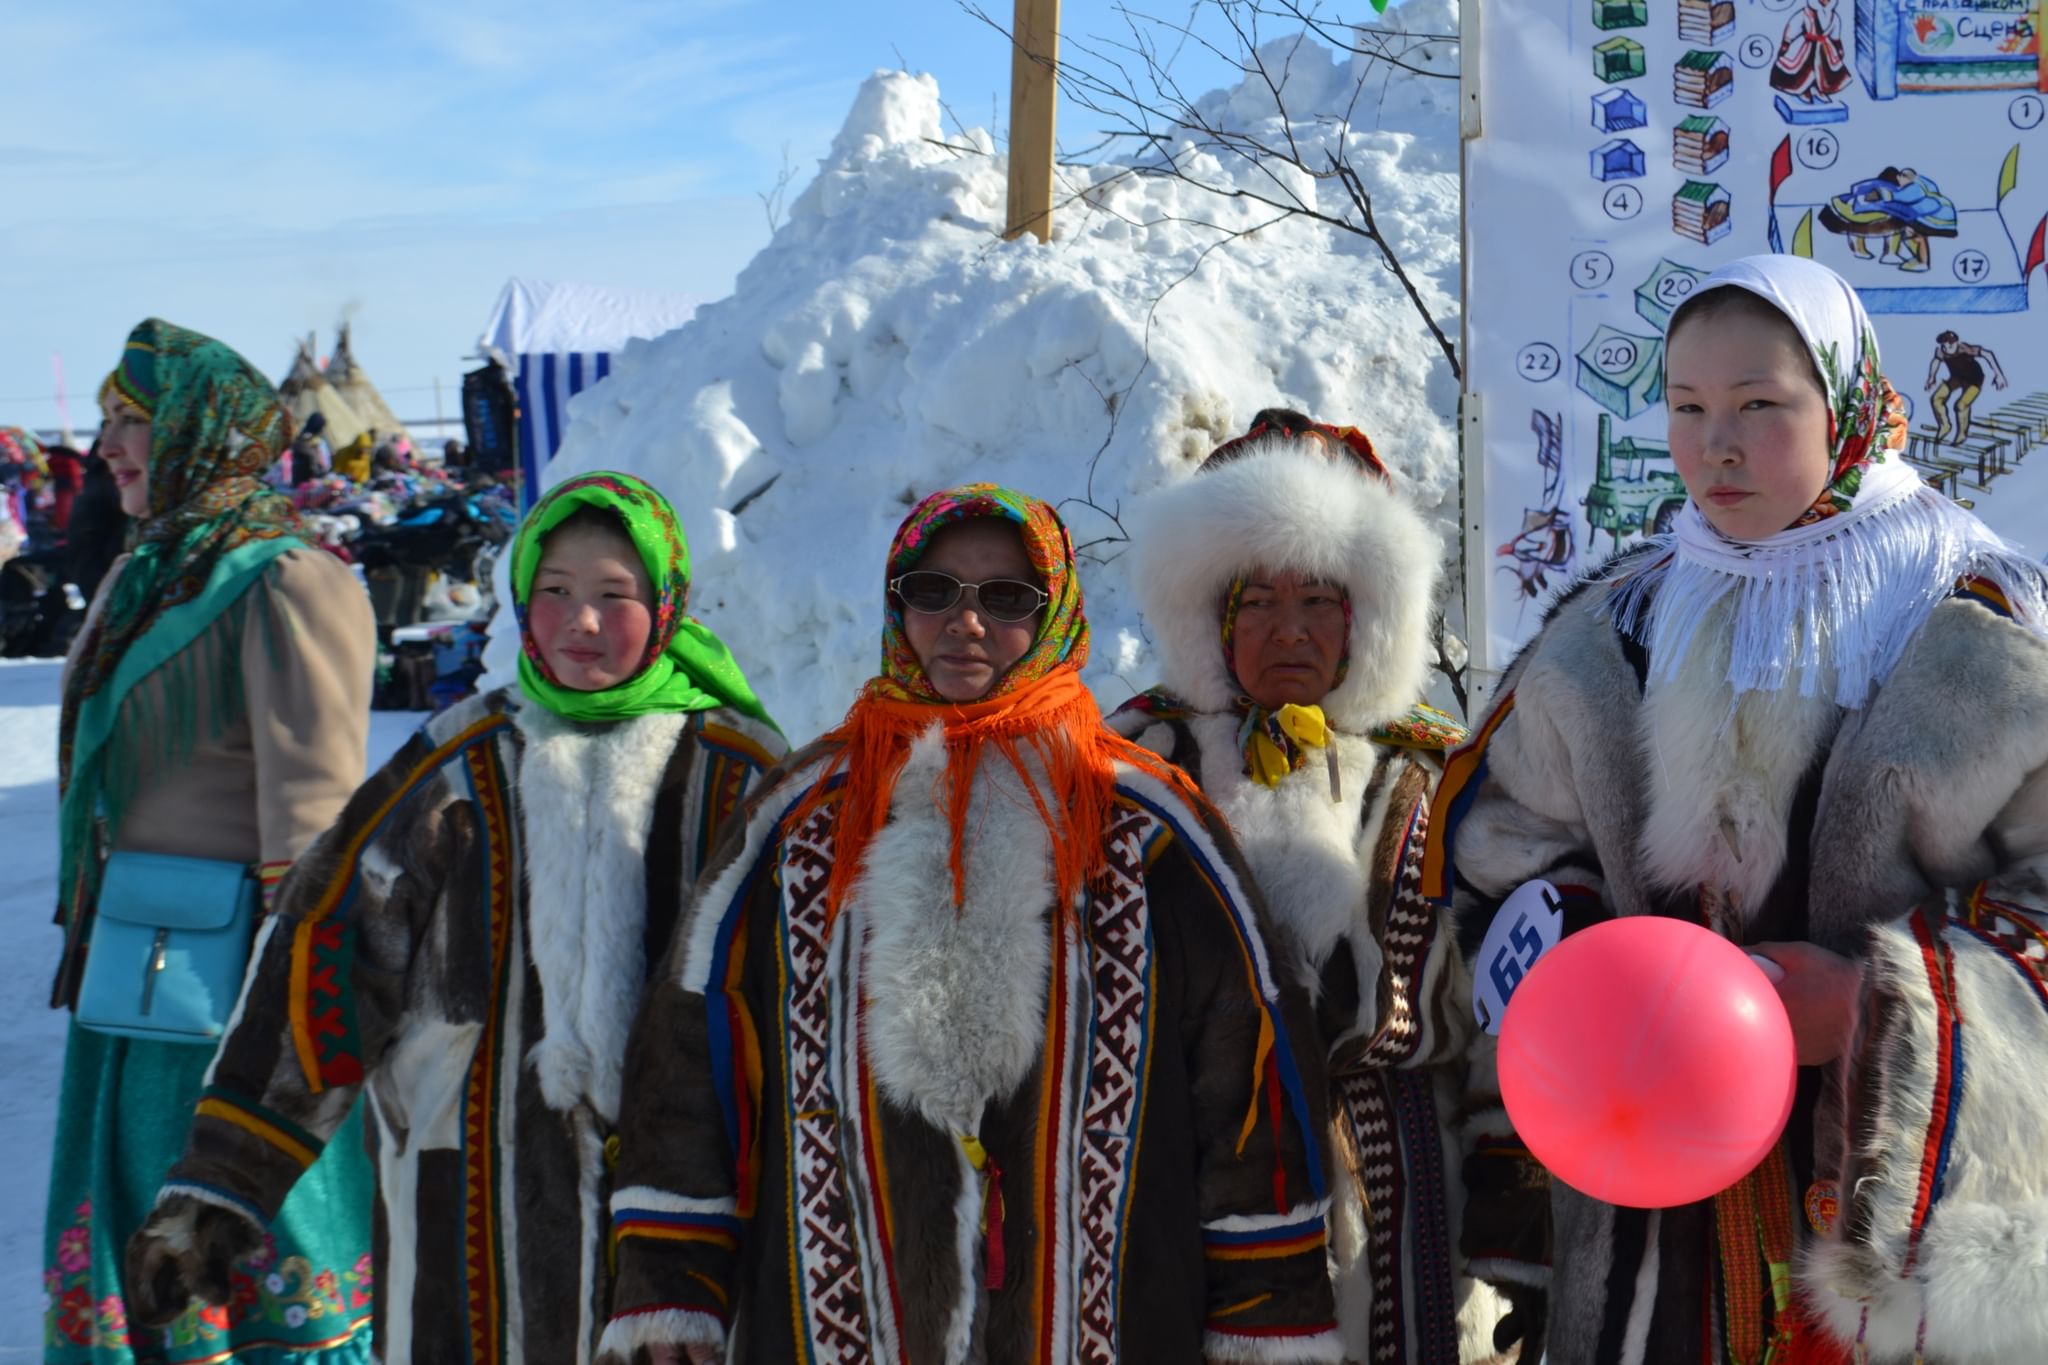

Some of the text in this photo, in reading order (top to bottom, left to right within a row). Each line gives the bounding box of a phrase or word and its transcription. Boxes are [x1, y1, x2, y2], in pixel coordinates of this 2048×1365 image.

[1957, 16, 2034, 42] Сцена
[1749, 39, 1764, 58] 6
[2021, 101, 2031, 118] 1
[1806, 136, 1831, 156] 16
[1612, 192, 1629, 212] 4
[1584, 258, 1600, 280] 5
[1959, 256, 1985, 277] 17
[1662, 278, 1693, 298] 20
[1525, 353, 1552, 370] 22
[1601, 347, 1632, 366] 20
[1489, 911, 1544, 1007] 65
